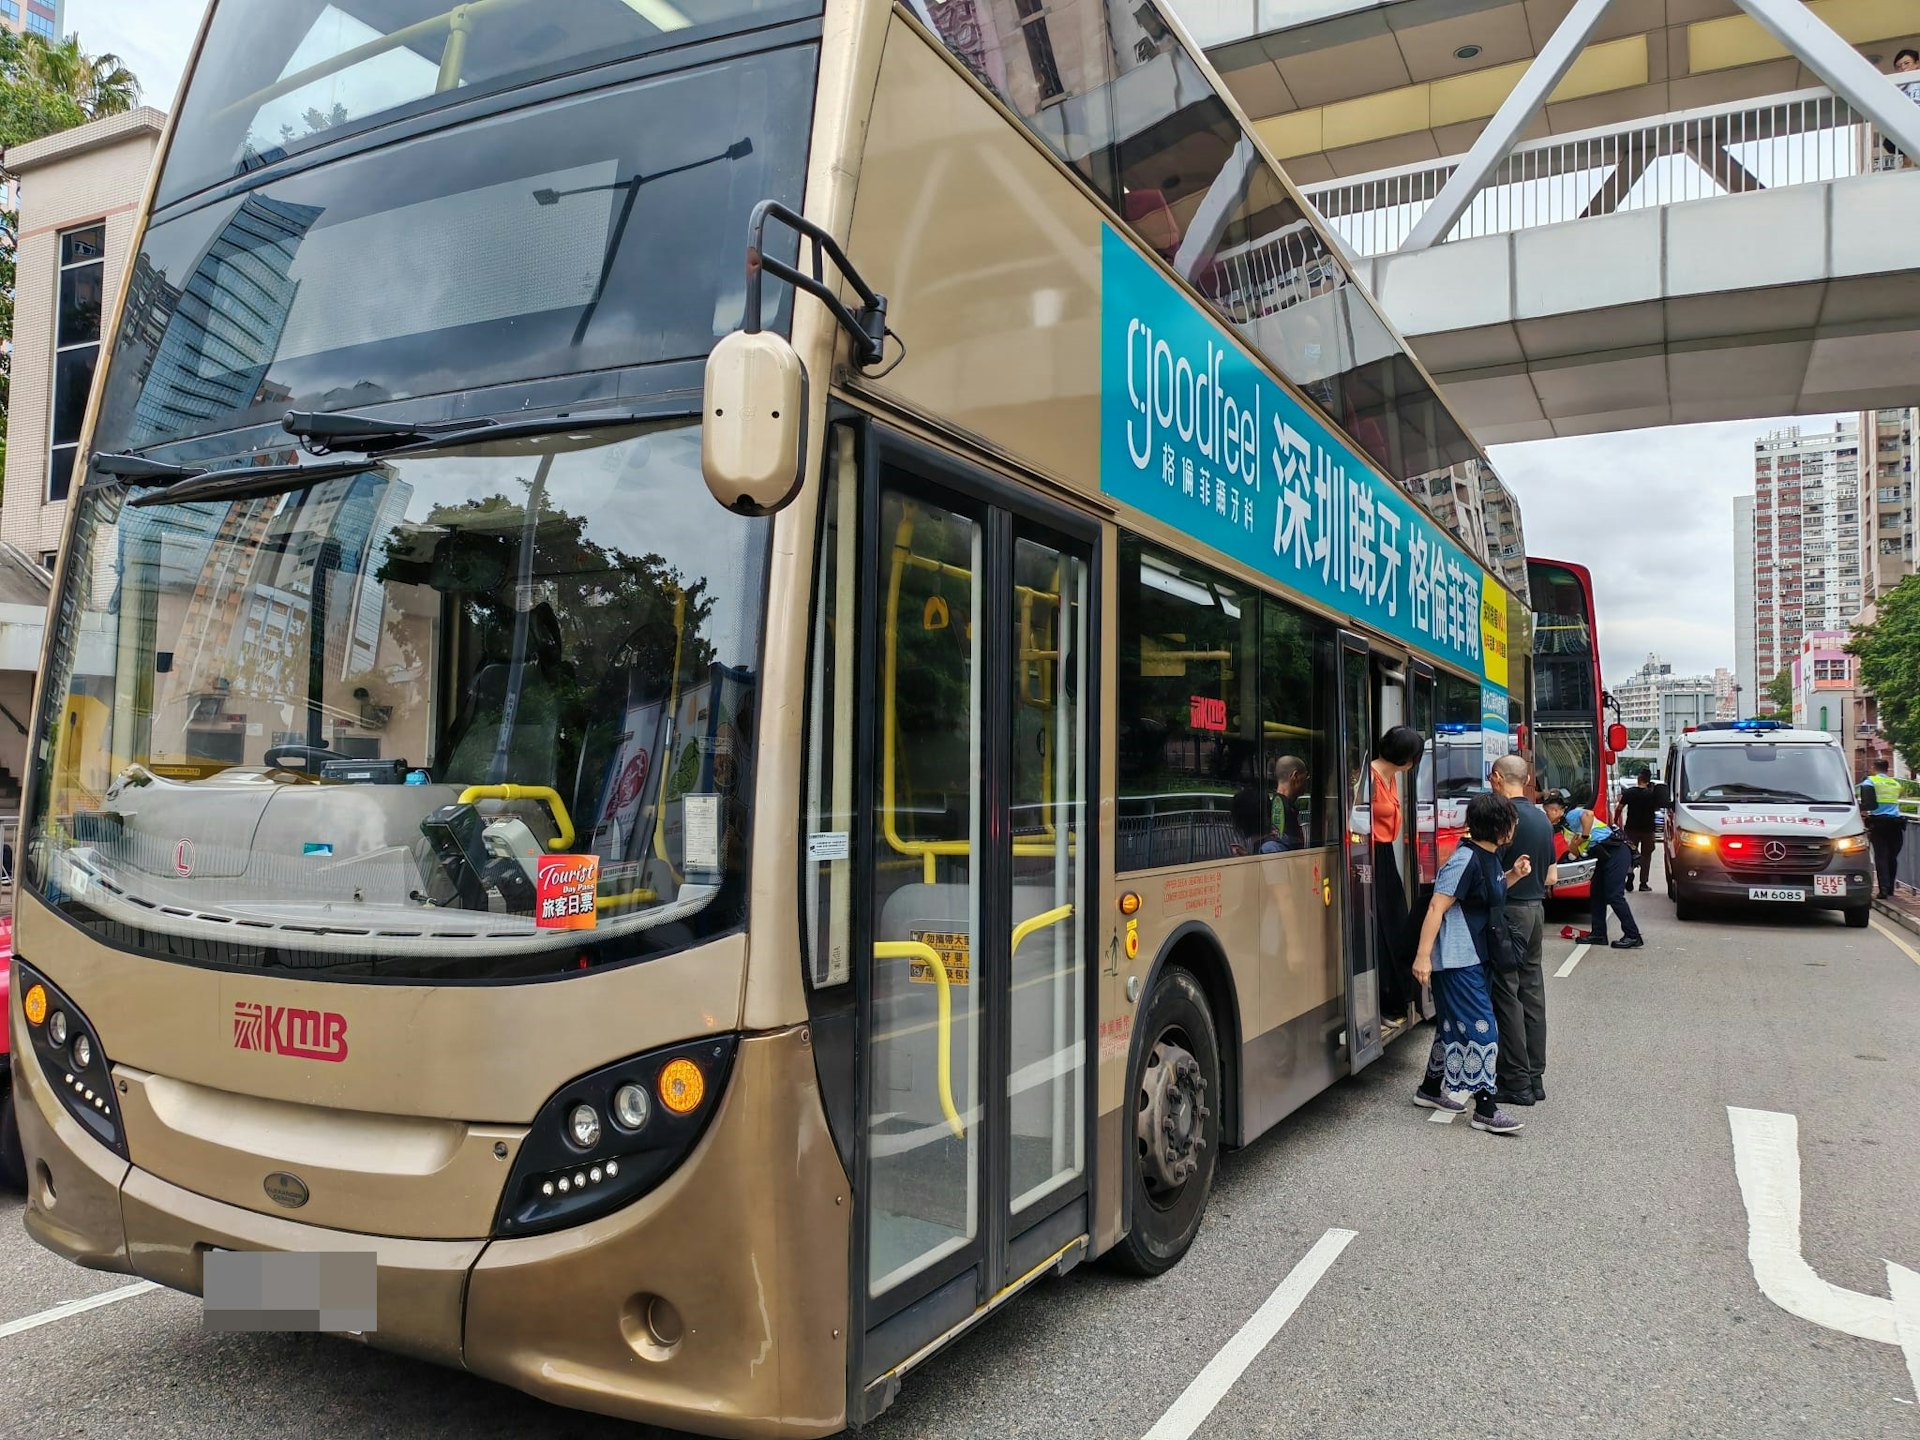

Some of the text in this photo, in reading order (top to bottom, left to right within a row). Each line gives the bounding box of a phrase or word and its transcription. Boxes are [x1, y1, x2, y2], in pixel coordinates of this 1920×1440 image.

[1127, 317, 1260, 493] goodfeel
[1161, 441, 1254, 533] 格倫菲爾牙科
[1272, 412, 1479, 661] 深圳睇牙 格倫菲爾
[1740, 815, 1805, 824] POLICE
[177, 844, 189, 870] L
[539, 863, 594, 891] Tourist
[563, 883, 595, 894] Day Pass
[542, 892, 594, 919] 旅客日票
[1753, 890, 1802, 900] AM 6085
[264, 1005, 349, 1063] KMB
